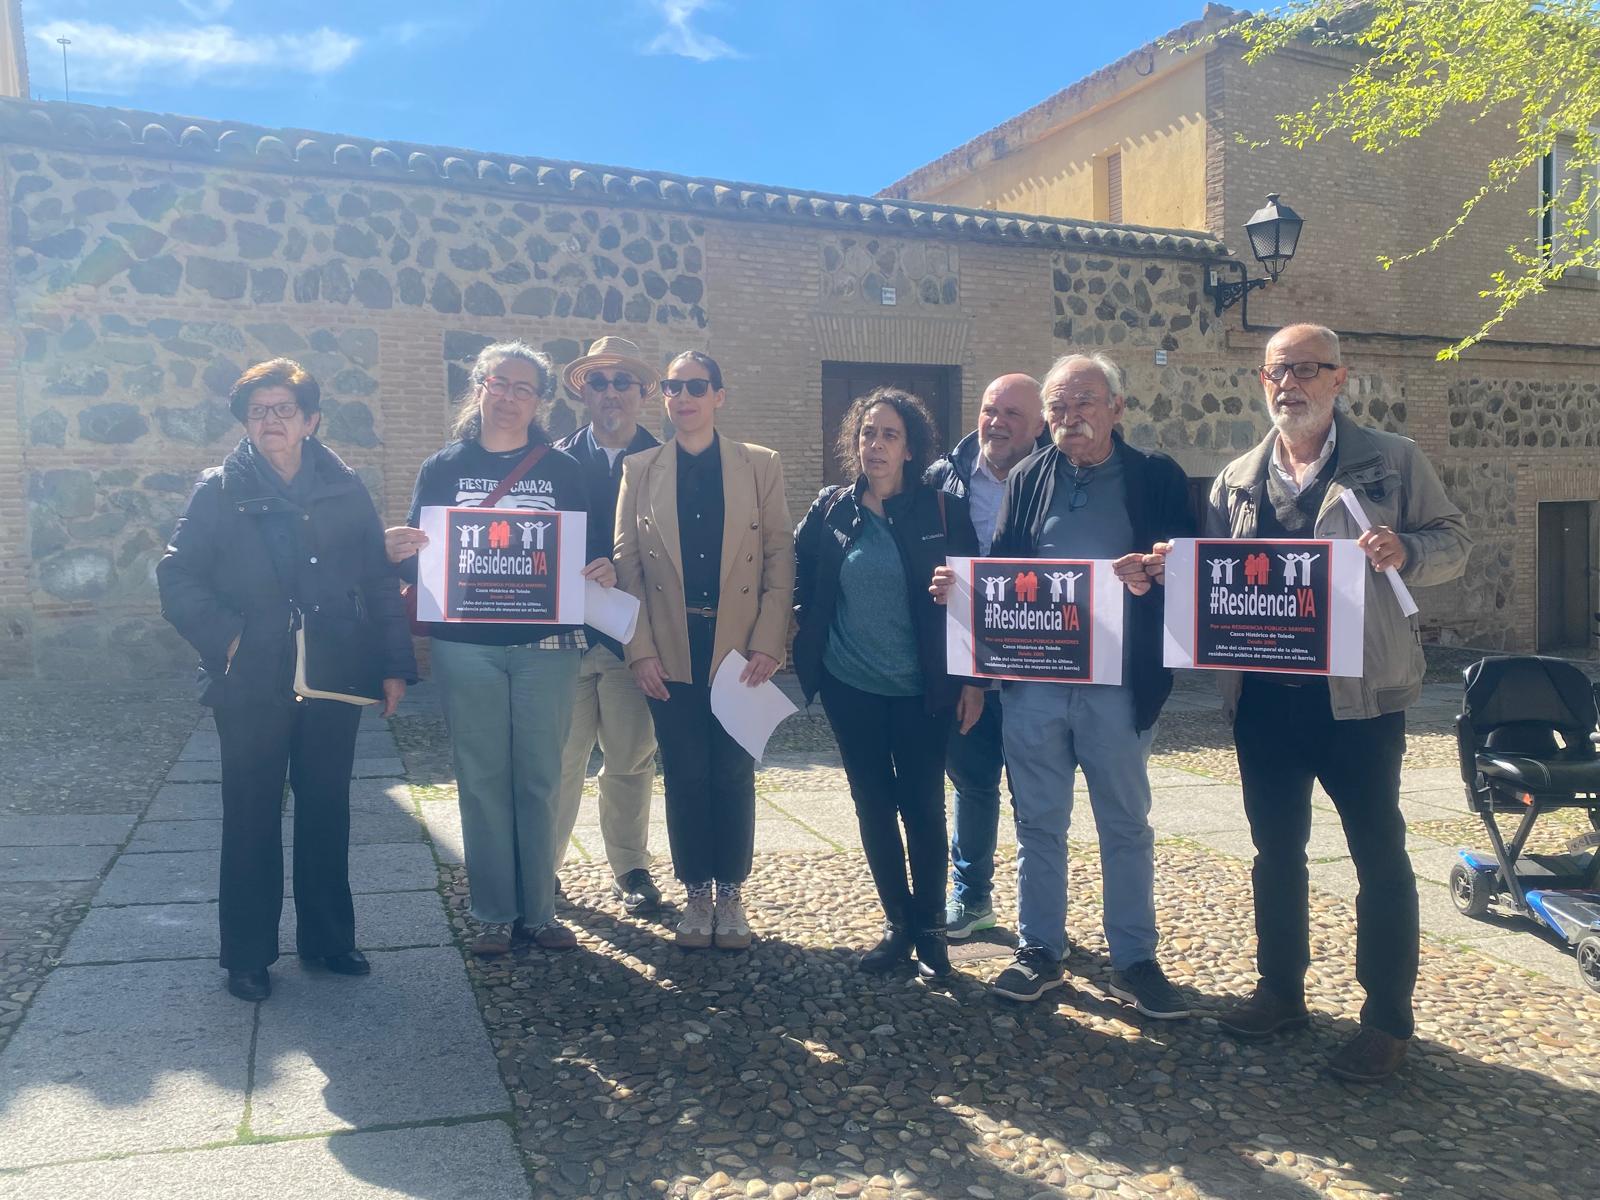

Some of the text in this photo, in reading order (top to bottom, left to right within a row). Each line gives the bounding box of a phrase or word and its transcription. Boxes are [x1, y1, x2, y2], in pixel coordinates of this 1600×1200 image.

[459, 549, 547, 576] #ResidenciaYA
[1210, 585, 1316, 618] #ResidenciaYA
[985, 602, 1080, 631] #ResidenciaYA
